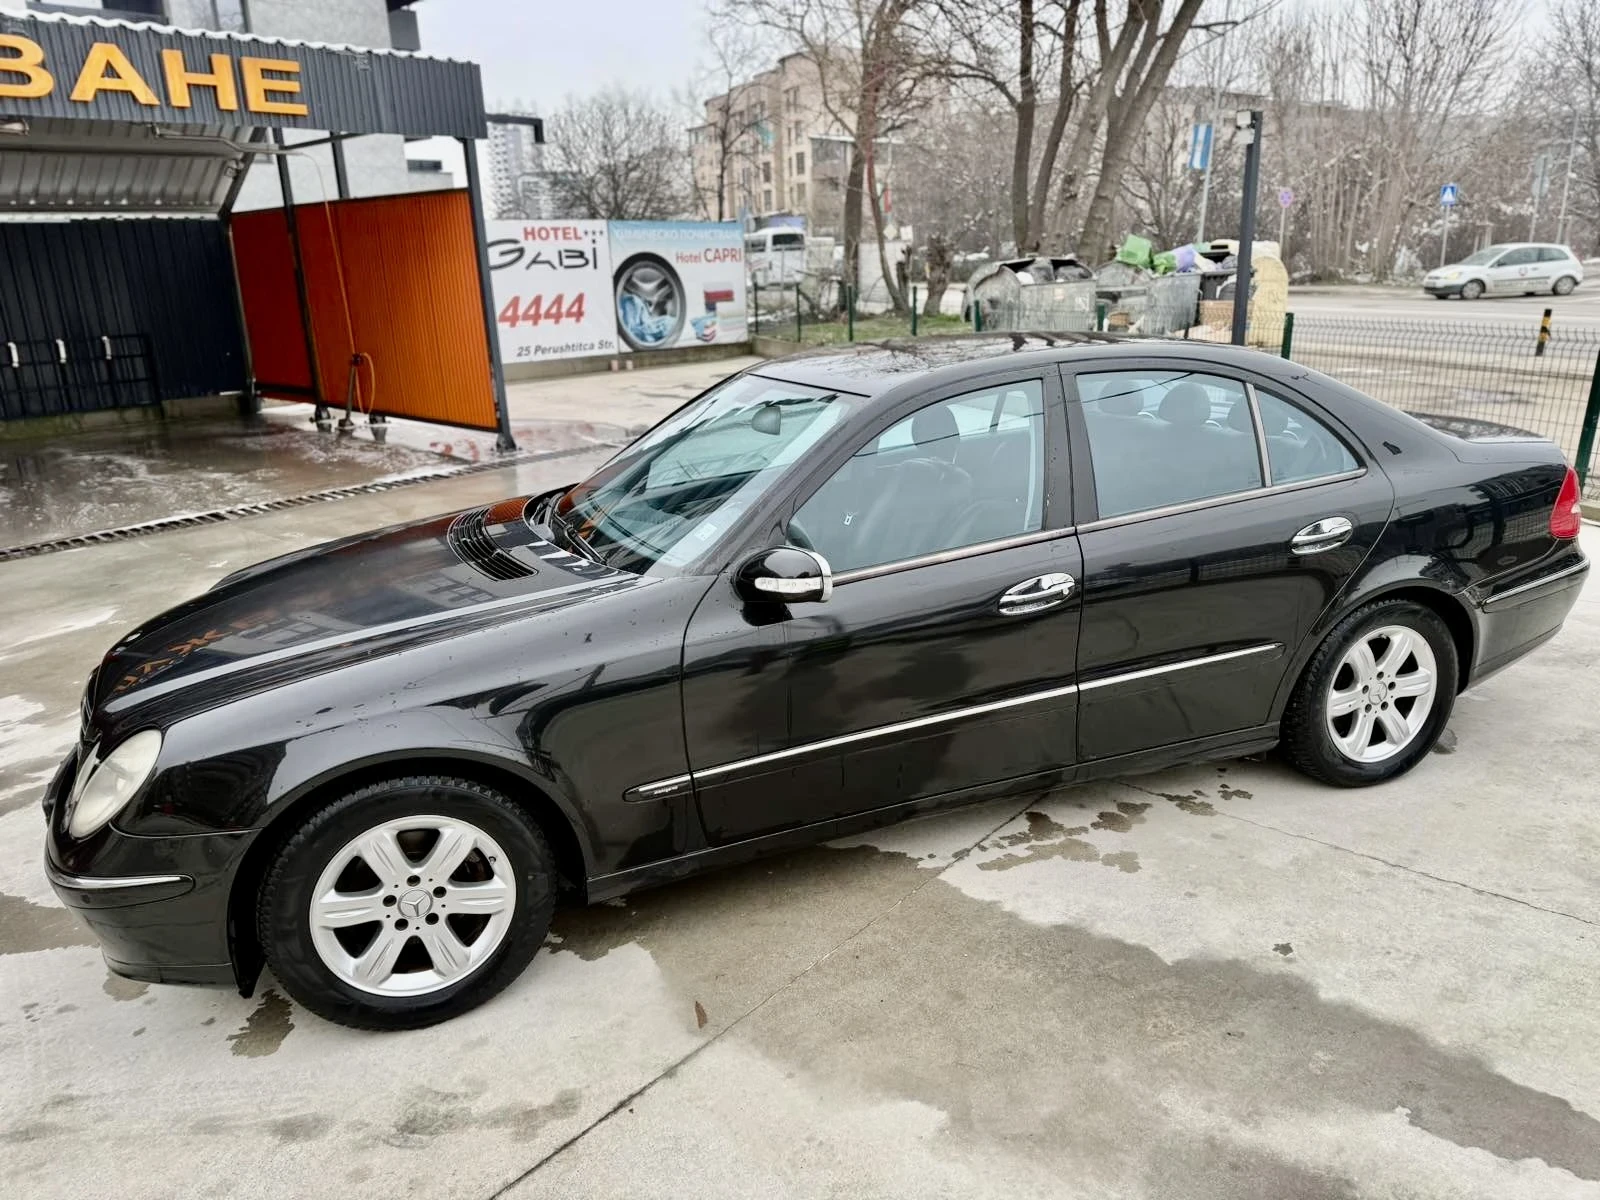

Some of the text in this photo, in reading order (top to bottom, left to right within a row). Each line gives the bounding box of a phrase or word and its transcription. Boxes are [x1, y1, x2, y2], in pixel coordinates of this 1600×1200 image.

[523, 226, 582, 241] HOTEL
[676, 248, 742, 264] Hotel CAPRI
[498, 292, 585, 328] 4444
[516, 339, 615, 357] 25 Perushtitca Str.
